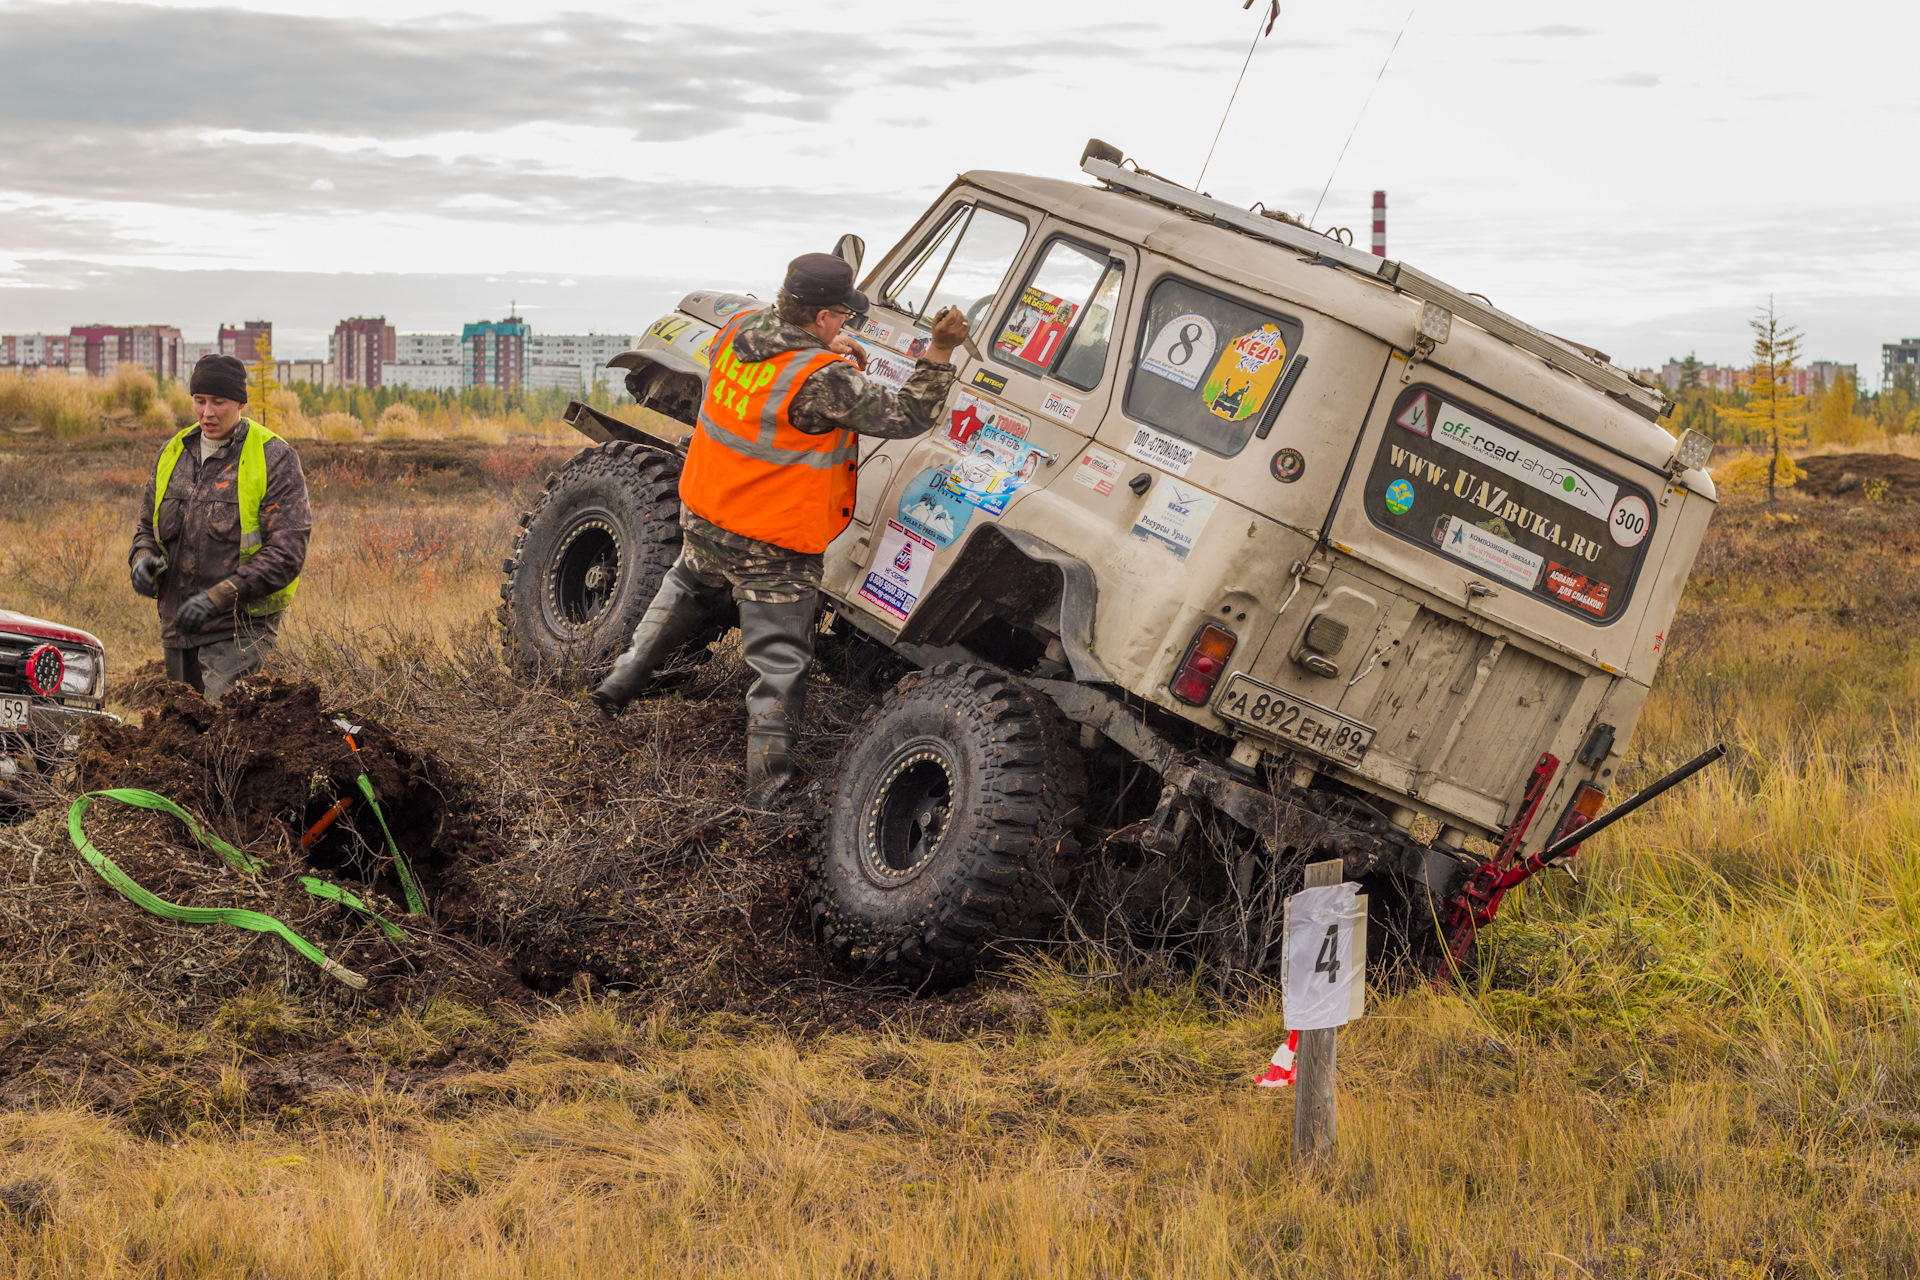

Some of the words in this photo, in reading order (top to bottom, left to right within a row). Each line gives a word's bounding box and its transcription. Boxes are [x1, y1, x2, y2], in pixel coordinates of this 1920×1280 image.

[1021, 293, 1032, 305] НА
[1031, 297, 1057, 315] БЕРЛИН
[1037, 329, 1059, 363] 1
[1167, 323, 1203, 366] 8
[1235, 338, 1279, 363] КЕДР
[1044, 398, 1070, 418] DRIVE
[957, 416, 971, 438] 1
[995, 414, 1029, 438] TOUGH
[1133, 429, 1151, 447] ООО
[983, 428, 999, 441] СТК
[999, 431, 1021, 451] ЯГЕЛЬ
[1440, 430, 1502, 461] ИНТЕРНЕТ-МАГАЗИН
[1140, 515, 1171, 534] Ресурсы
[1171, 528, 1193, 544] Урала
[1615, 508, 1644, 535] 300
[1469, 533, 1509, 555] КОМПОЗИЦИЯ
[868, 573, 874, 582] 8
[873, 575, 884, 588] 800
[882, 580, 897, 595] 5000
[894, 587, 907, 601] 392
[1550, 570, 1577, 588] АСФАЛЬТ
[1557, 584, 1573, 597] ДЛЯ
[1571, 591, 1604, 611] СЛАБАКОВ!
[4, 700, 23, 721] 59
[1328, 744, 1347, 757] RUS
[1335, 726, 1363, 751] 89
[1314, 923, 1341, 984] 4
